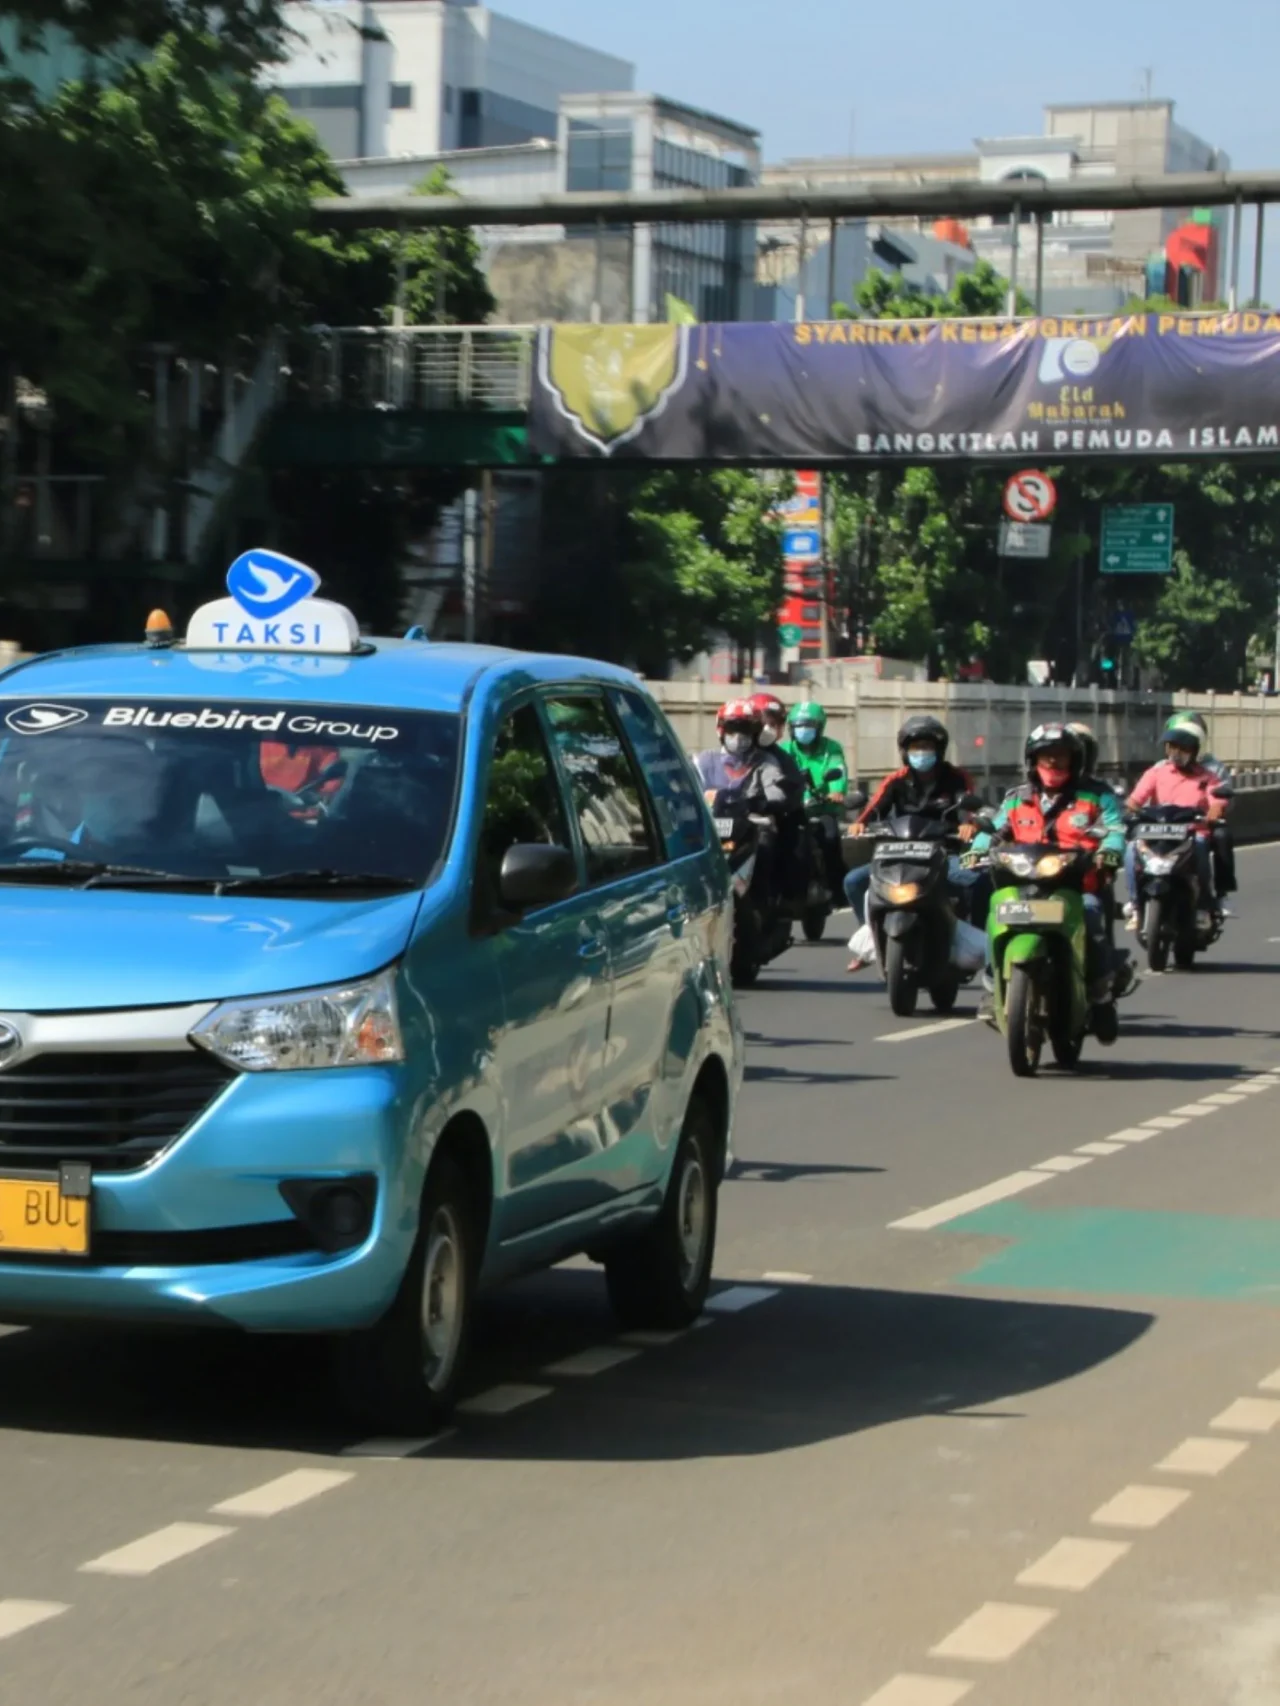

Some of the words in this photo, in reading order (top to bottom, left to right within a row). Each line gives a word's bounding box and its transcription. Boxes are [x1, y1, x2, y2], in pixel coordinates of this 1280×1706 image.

[1158, 312, 1280, 337] PEMUDA
[856, 430, 1039, 453] BANGKITLAH
[1053, 427, 1173, 450] PEMUDA
[1188, 425, 1279, 447] ISLAM
[212, 622, 321, 645] TAKSI
[101, 706, 286, 732] Bluebird
[287, 715, 399, 742] Group
